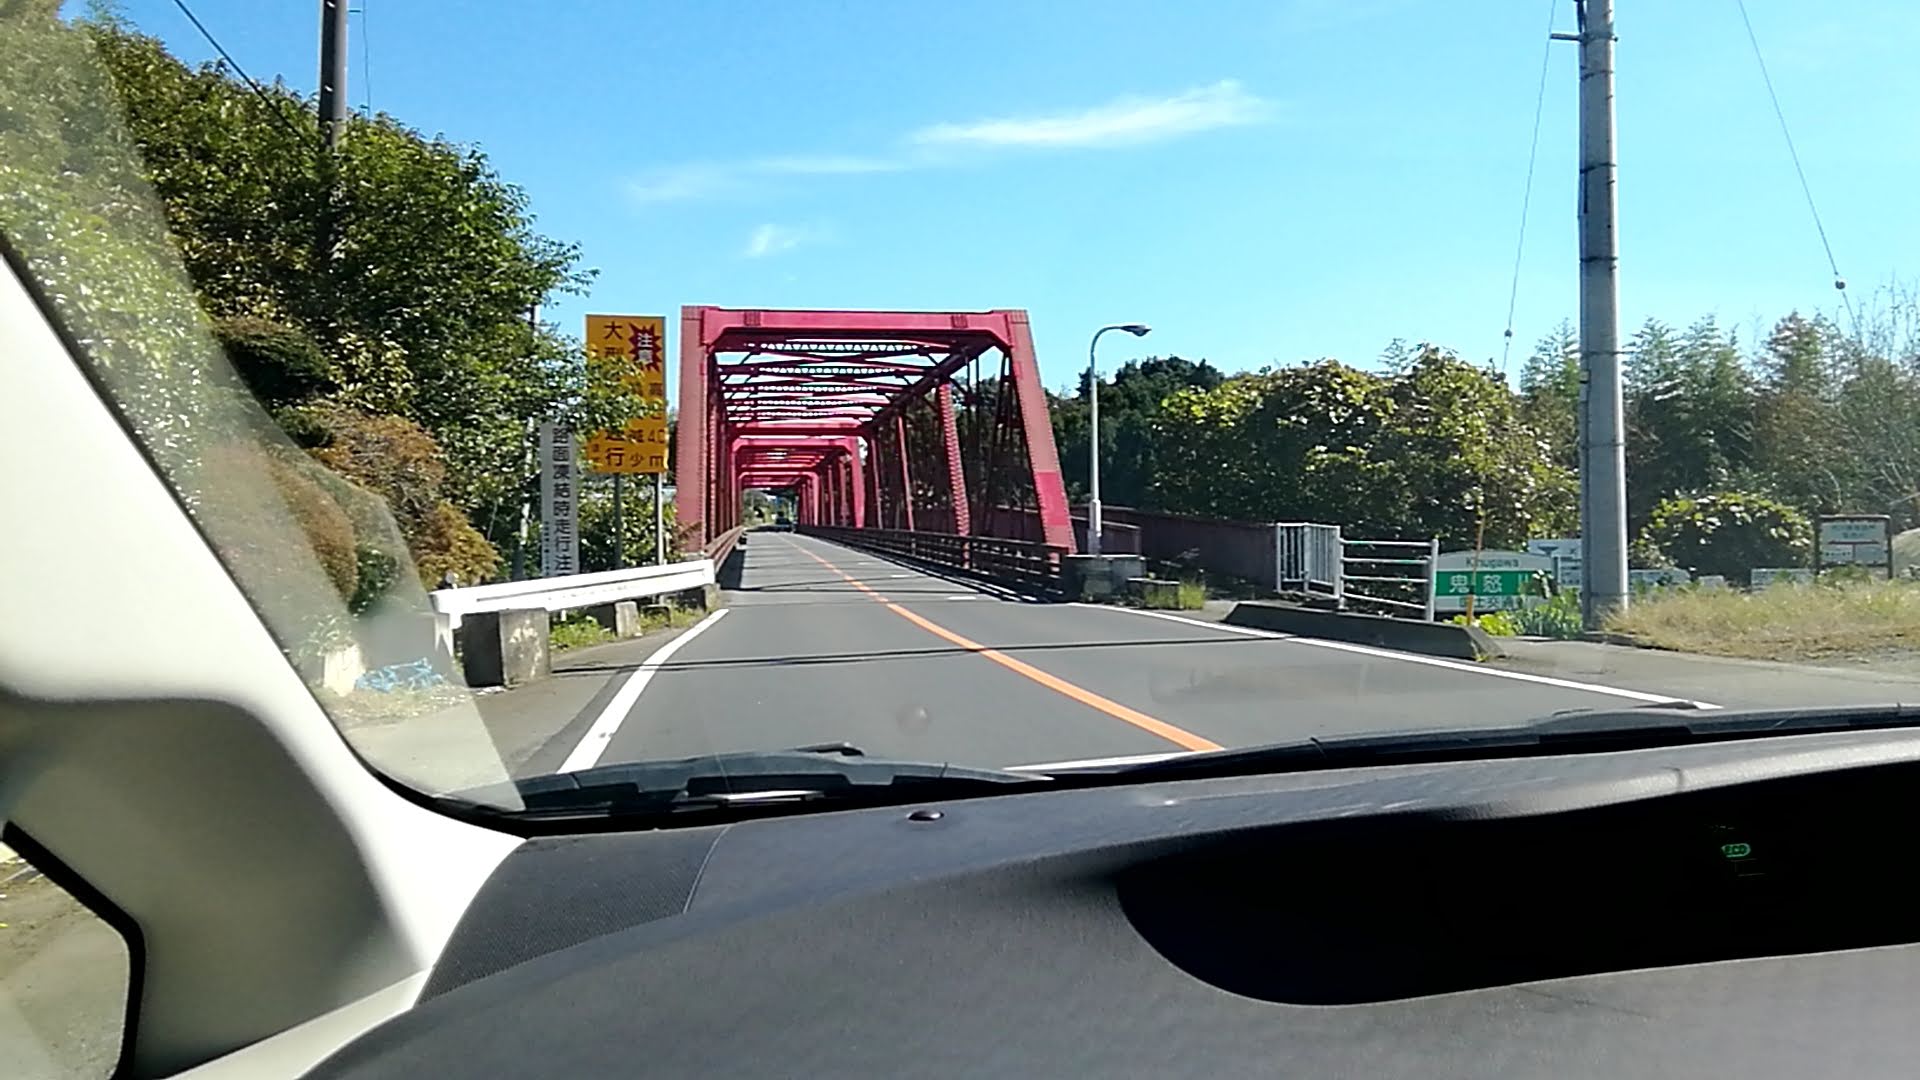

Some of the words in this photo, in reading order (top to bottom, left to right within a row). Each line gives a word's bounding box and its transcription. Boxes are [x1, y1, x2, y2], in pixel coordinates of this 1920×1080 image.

[552, 427, 573, 576] 路面凍結時走行注
